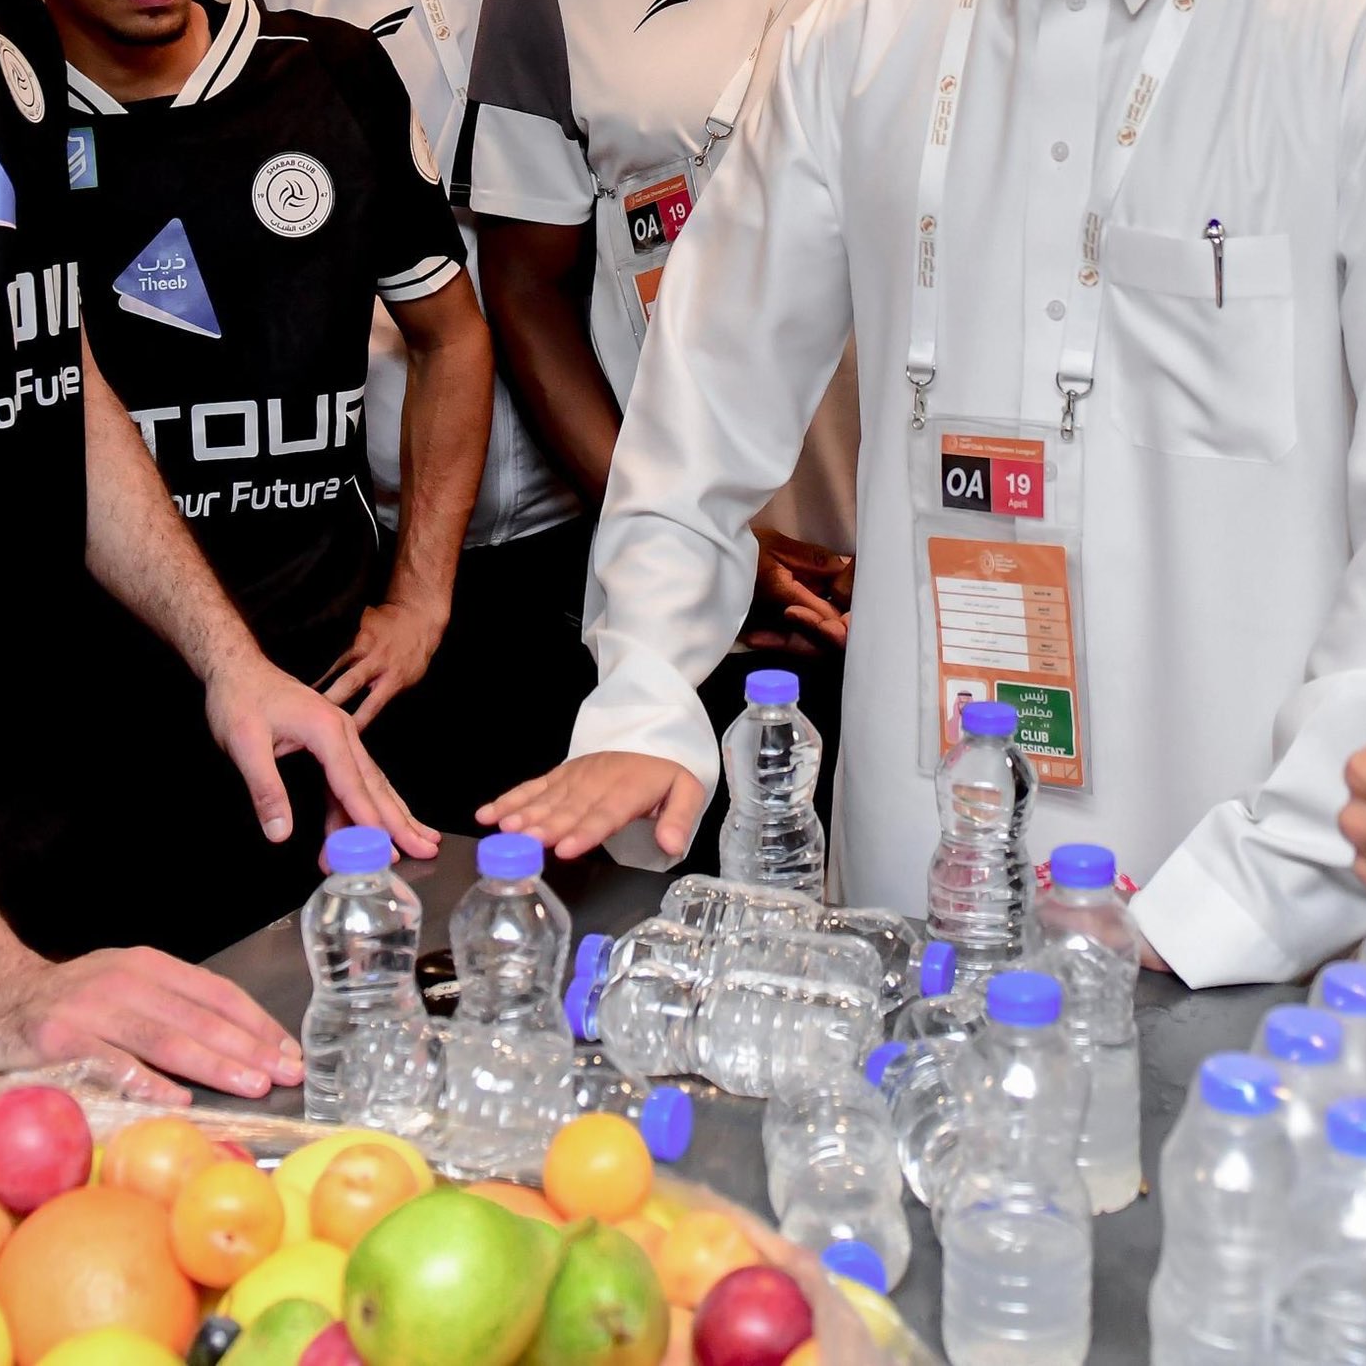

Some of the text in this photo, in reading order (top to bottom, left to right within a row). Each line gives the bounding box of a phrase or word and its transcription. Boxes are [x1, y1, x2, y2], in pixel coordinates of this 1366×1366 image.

[266, 160, 316, 175] SHABAB CLUB
[669, 202, 686, 222] 19
[634, 213, 659, 241] OA
[137, 253, 187, 275] ذيب
[138, 275, 187, 291] Theeb
[946, 467, 984, 499] OA
[1005, 473, 1031, 495] 19
[231, 478, 340, 513] Future
[1020, 729, 1049, 743] CLUB
